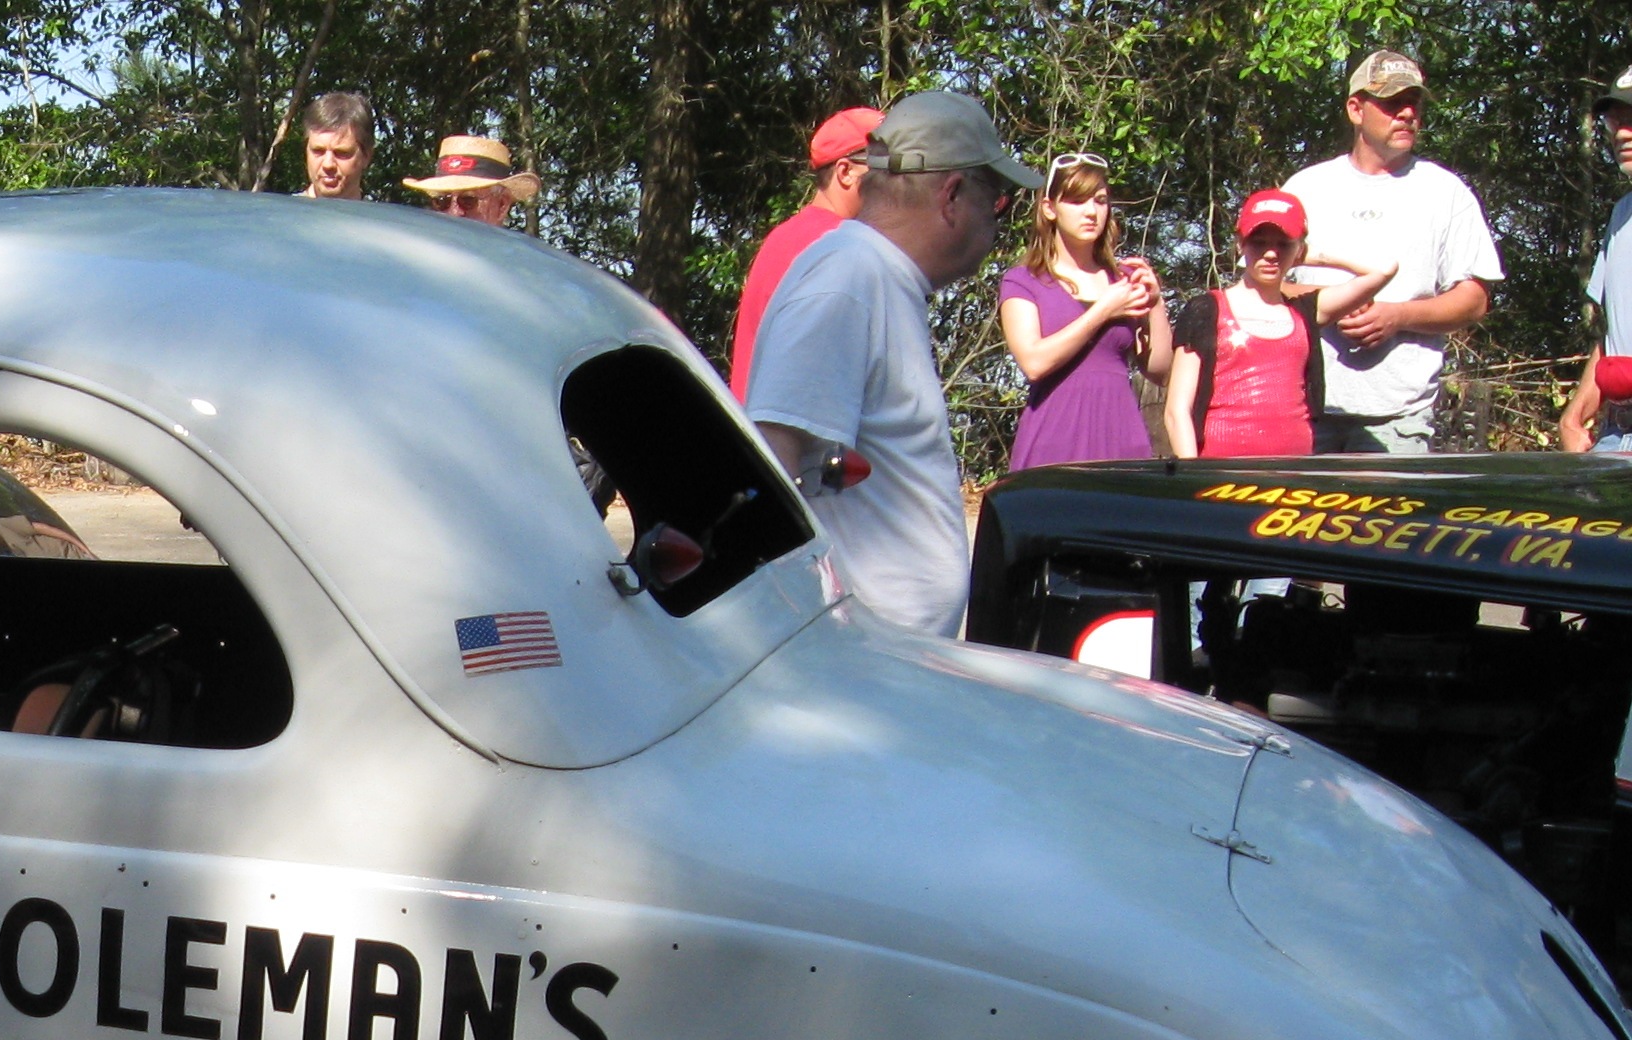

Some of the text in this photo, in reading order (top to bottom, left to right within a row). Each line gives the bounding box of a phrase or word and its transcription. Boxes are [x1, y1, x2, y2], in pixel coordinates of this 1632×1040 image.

[1199, 482, 1427, 517] MASON'S
[1252, 507, 1575, 570] BASSETT, VA.
